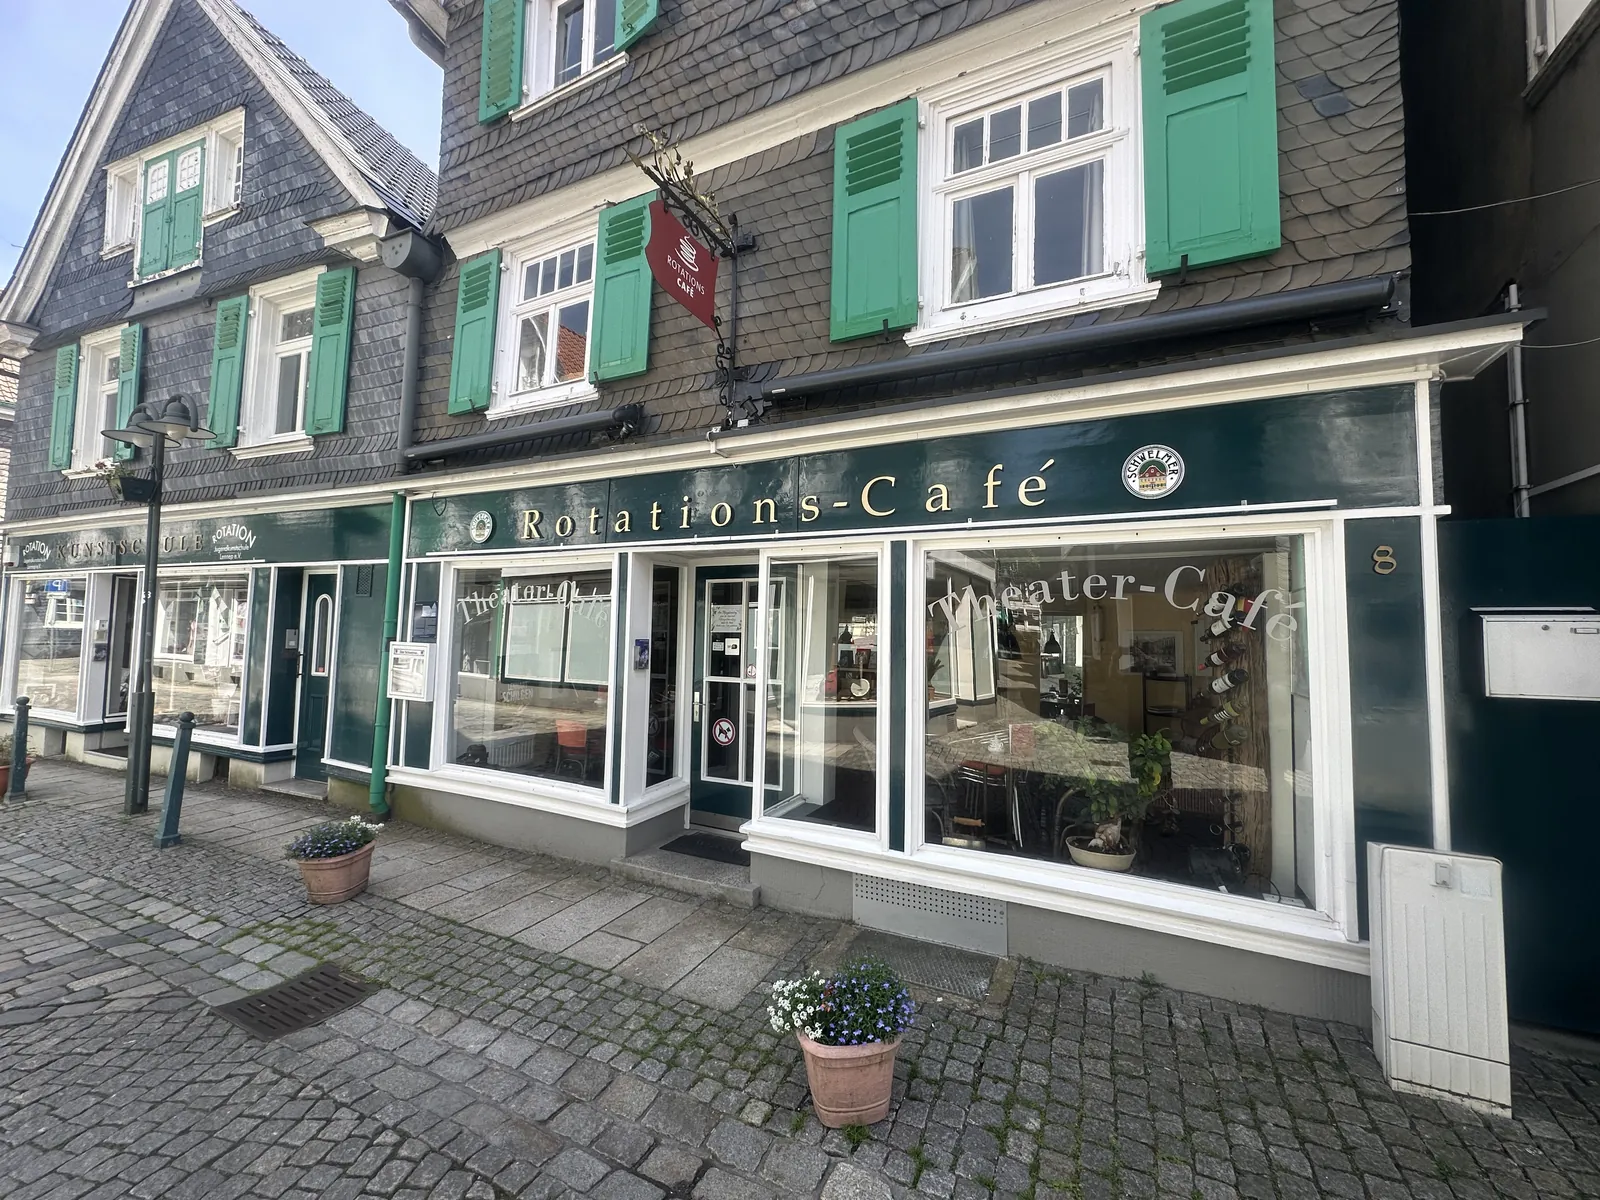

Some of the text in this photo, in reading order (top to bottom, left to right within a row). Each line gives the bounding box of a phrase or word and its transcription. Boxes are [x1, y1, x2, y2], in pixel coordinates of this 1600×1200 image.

[667, 255, 705, 295] ROTATIONS
[676, 277, 694, 298] CAFÉ
[1127, 449, 1179, 479] SCHWELMER
[520, 459, 1056, 540] Rotations-Café
[22, 540, 51, 560] ROTATION
[56, 534, 204, 560] KUNSTSCULE
[212, 523, 257, 549] ROTATION
[1372, 545, 1397, 576] 8
[927, 565, 1306, 643] Theater-Café
